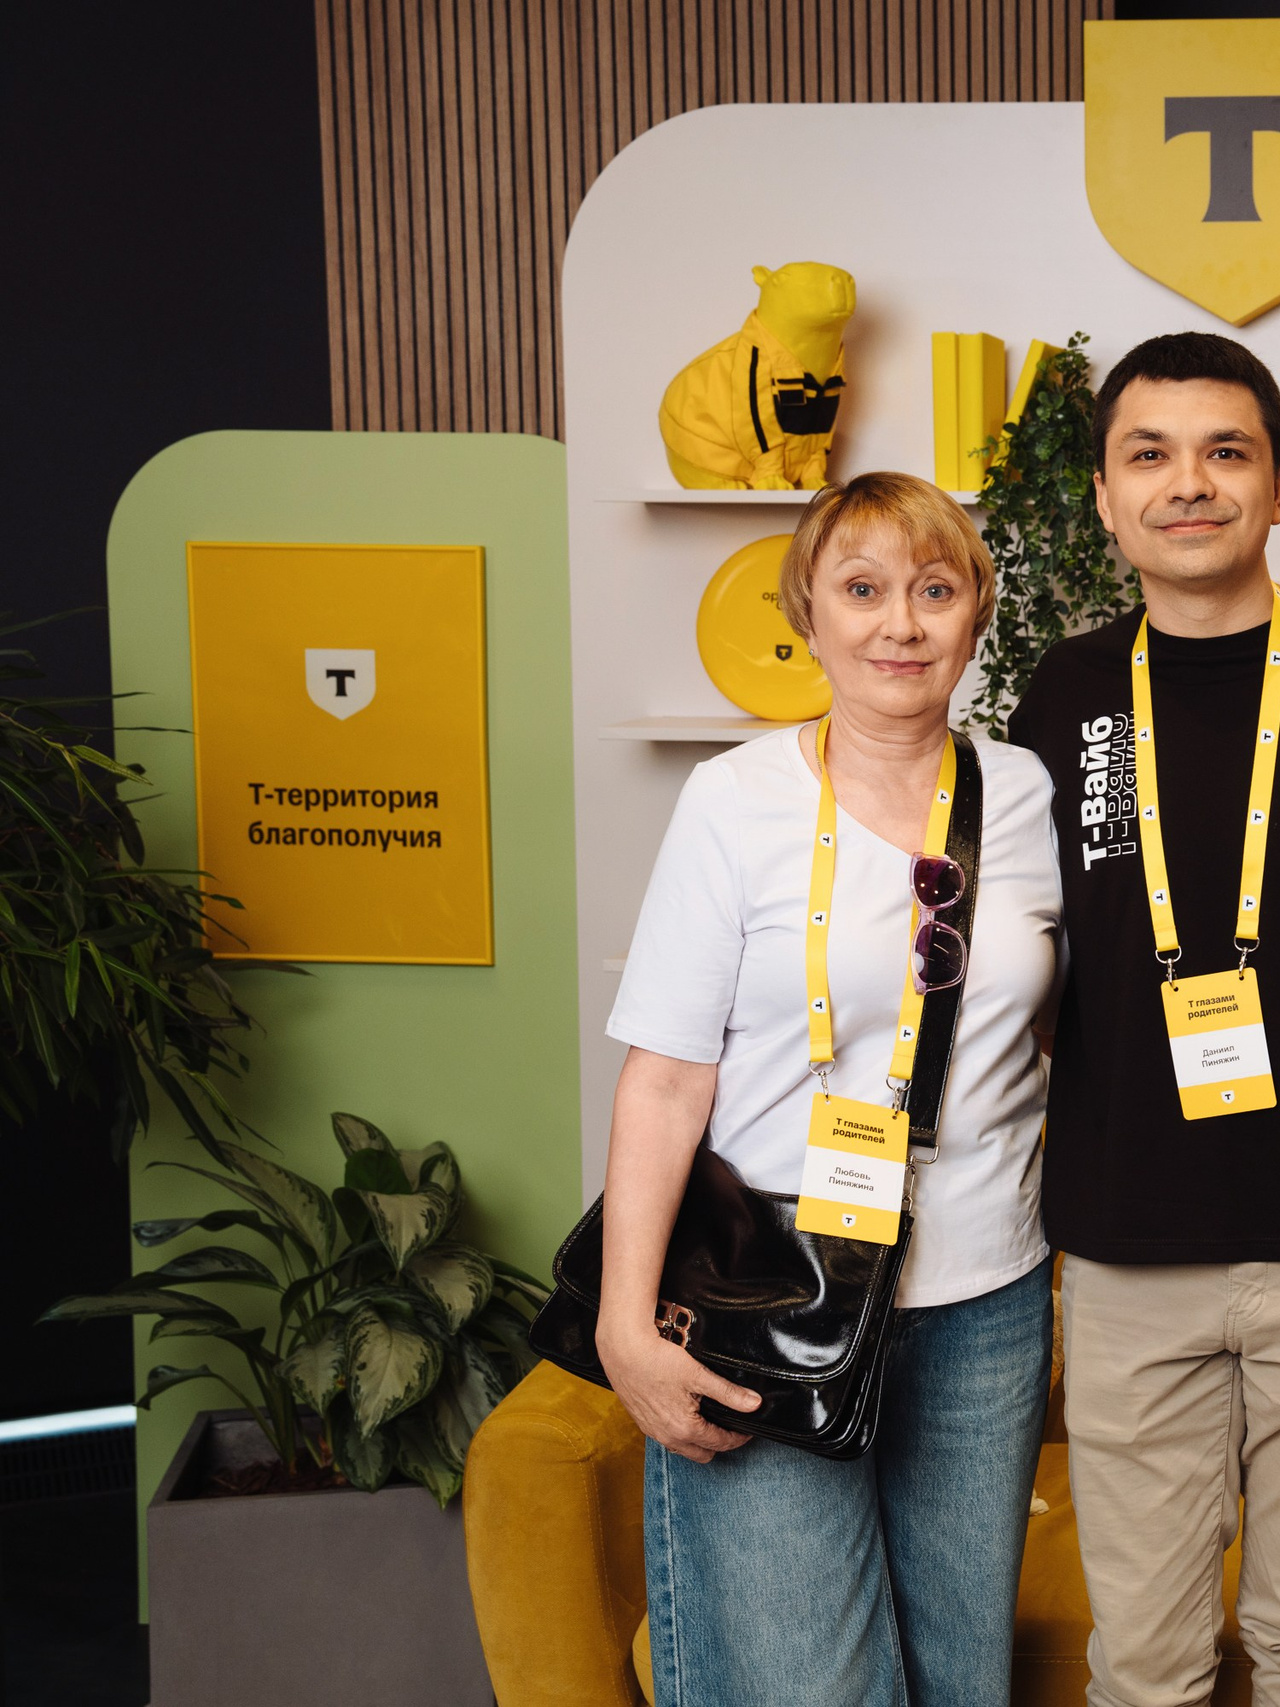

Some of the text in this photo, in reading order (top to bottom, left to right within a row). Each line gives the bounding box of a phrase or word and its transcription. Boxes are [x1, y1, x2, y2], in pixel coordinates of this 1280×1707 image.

[248, 783, 438, 813] Т-территория
[1080, 716, 1113, 871] Т-Вайб
[248, 822, 442, 853] благополучия
[1196, 994, 1235, 1007] глазами
[1188, 1003, 1239, 1020] родителей
[1203, 1045, 1235, 1058] Даниил
[832, 1127, 885, 1144] родителей
[844, 1120, 884, 1135] глазами
[834, 1166, 871, 1181] Любовь
[828, 1176, 874, 1192] Пиняжина
